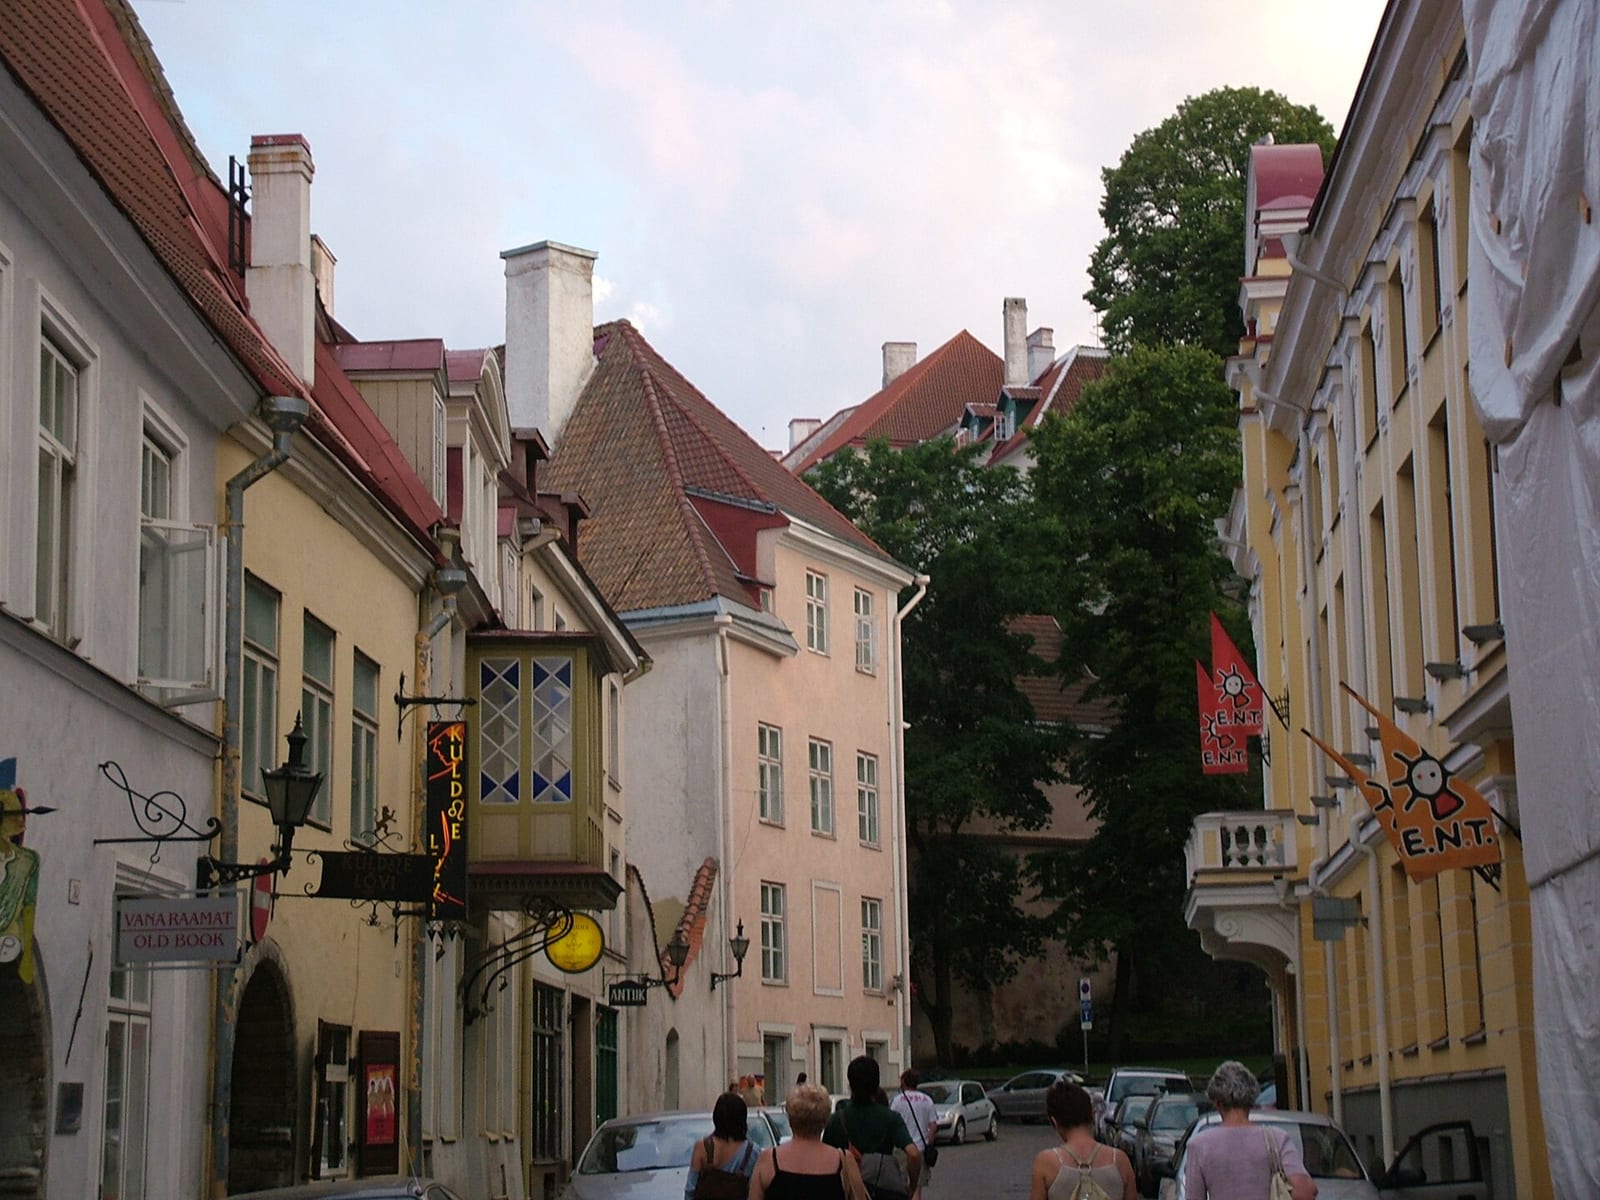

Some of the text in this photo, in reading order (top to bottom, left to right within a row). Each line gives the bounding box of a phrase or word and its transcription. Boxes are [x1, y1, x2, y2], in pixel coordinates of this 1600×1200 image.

[1216, 709, 1263, 727] E.N.T.
[1202, 749, 1248, 766] E.N.T.
[1401, 818, 1493, 857] E.N.T.
[125, 911, 233, 927] VANA RAAMAT
[133, 932, 224, 948] OLD BOOK
[610, 988, 646, 1001] ANTIIK
